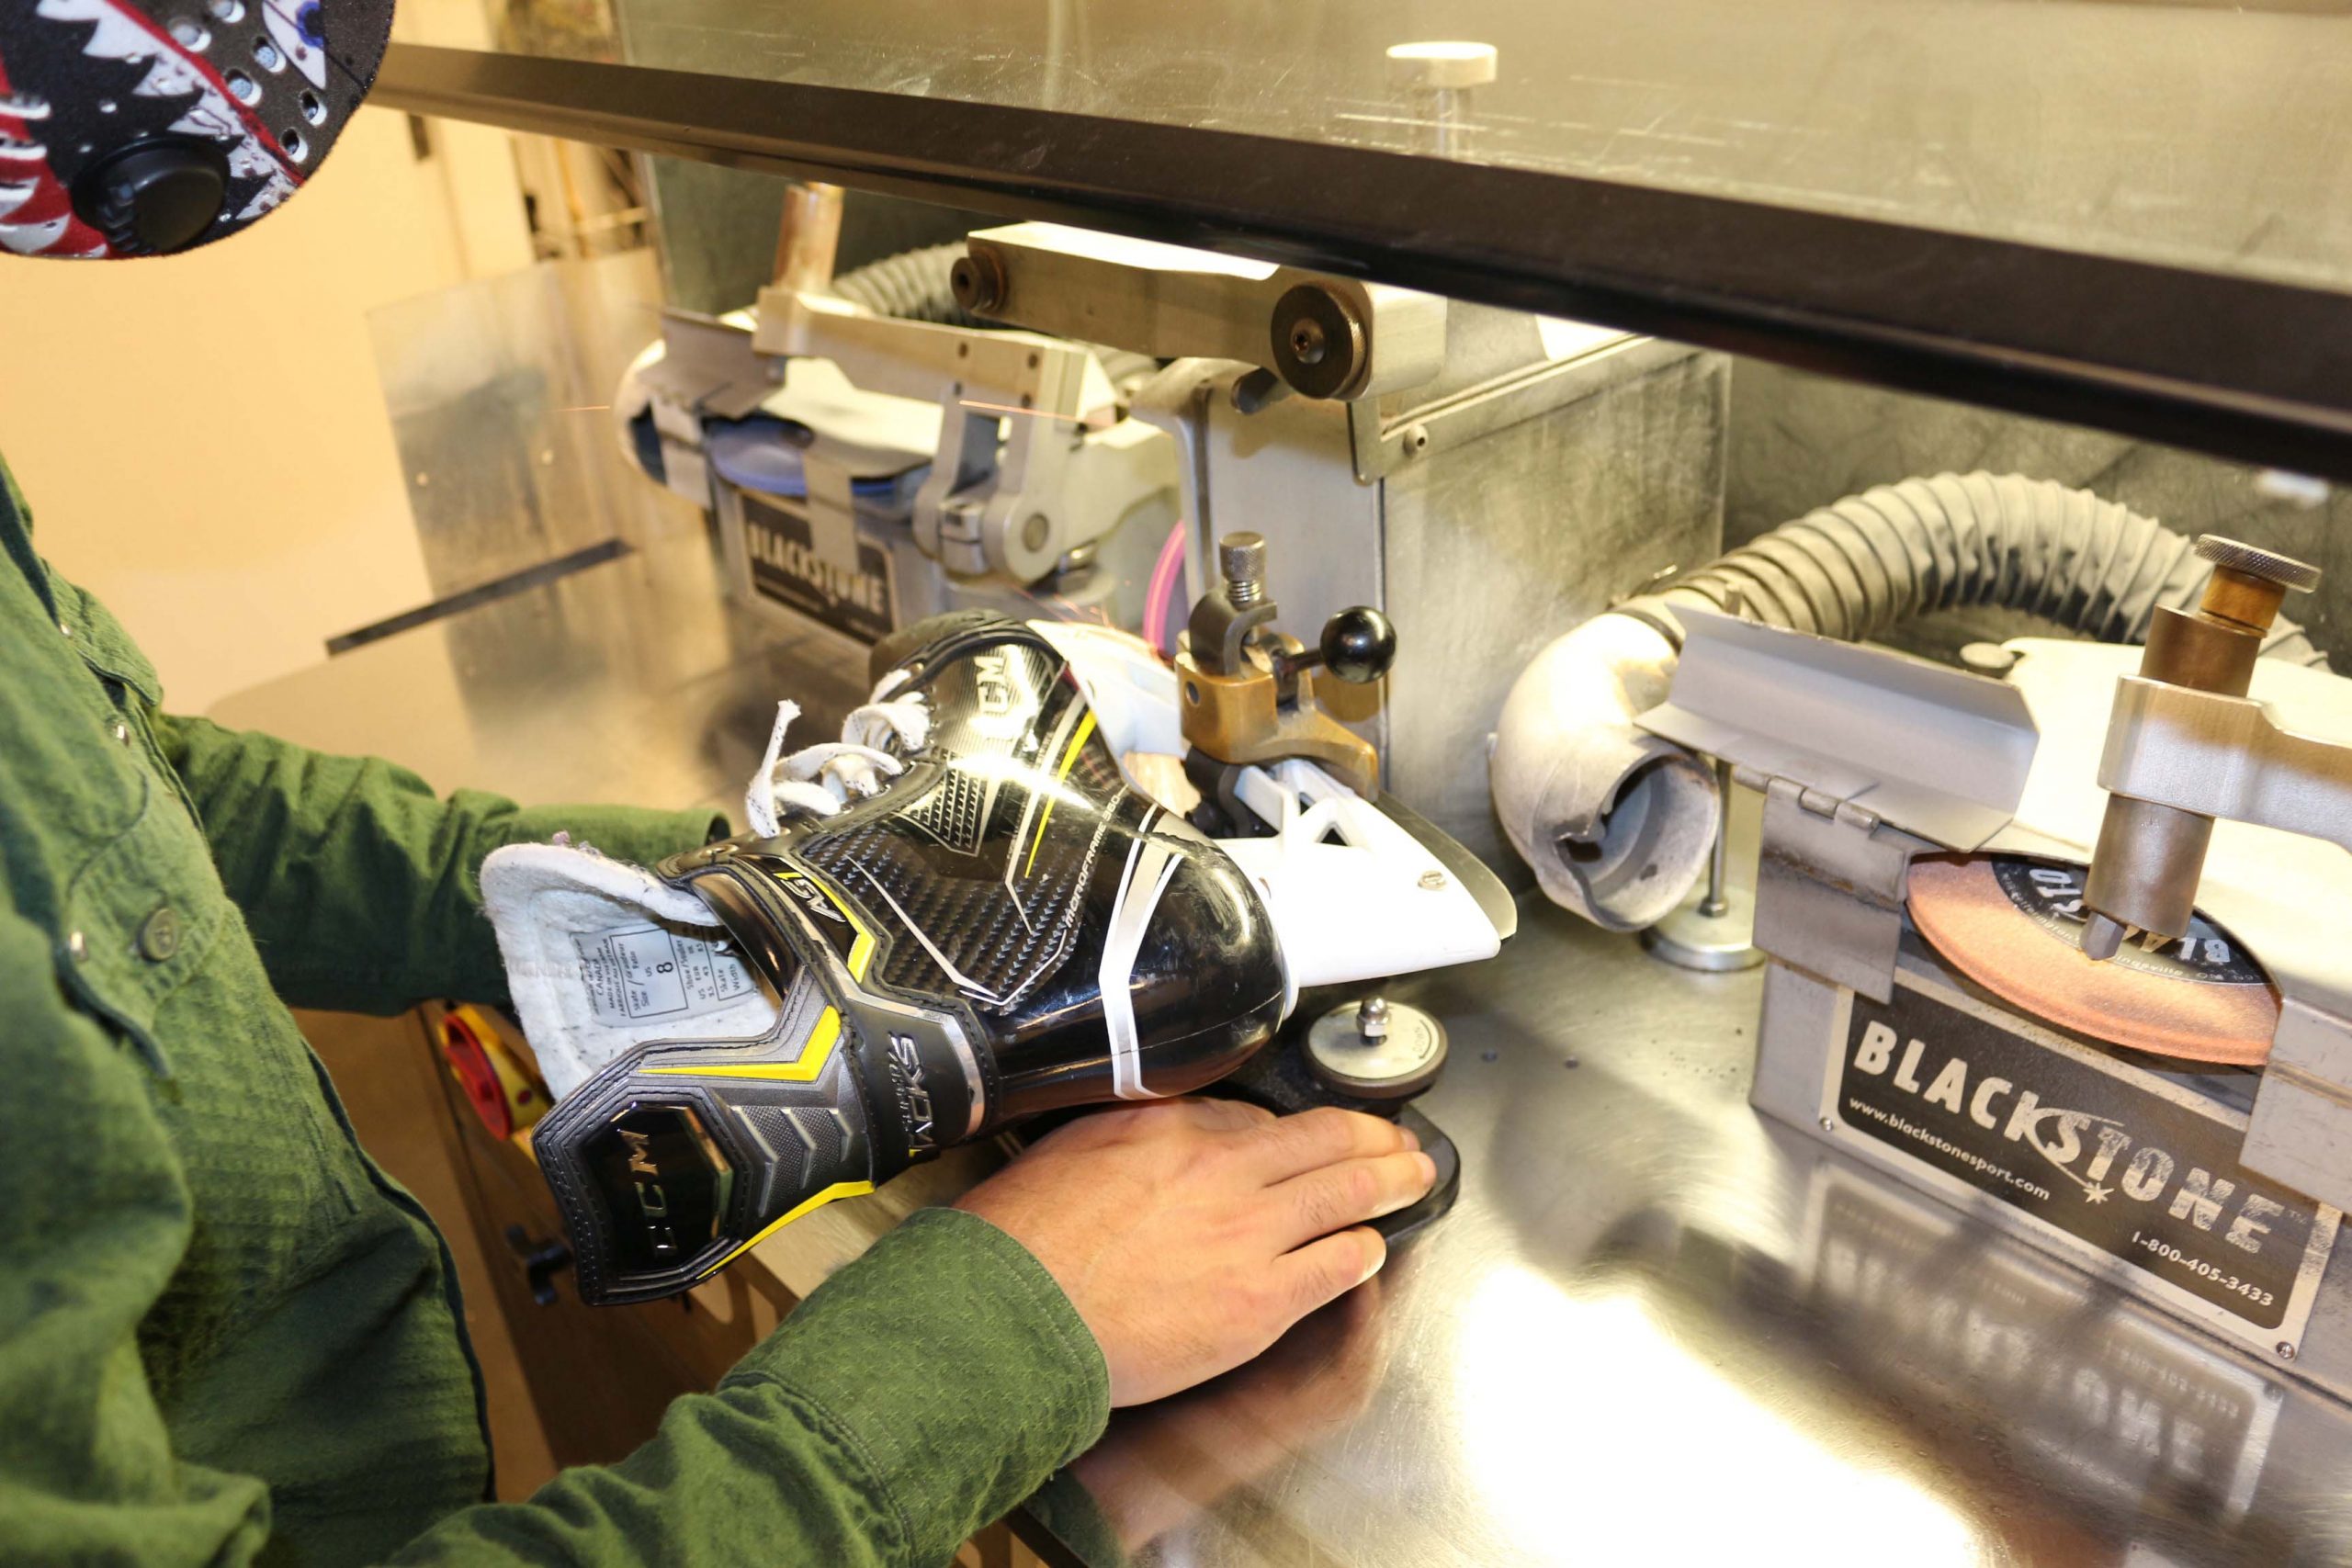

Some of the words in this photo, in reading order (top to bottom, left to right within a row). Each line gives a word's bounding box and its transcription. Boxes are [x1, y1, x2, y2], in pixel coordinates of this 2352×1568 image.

[971, 655, 1016, 740] CM
[1065, 821, 1106, 928] MONOFRAME
[1102, 794, 1120, 821] 360
[645, 966, 652, 977] US
[656, 961, 673, 974] 8
[729, 964, 741, 990] Width
[2115, 954, 2184, 976] ingsville
[718, 968, 729, 992] Skate
[640, 991, 650, 1007] Size
[698, 988, 707, 999] US
[1849, 1098, 2051, 1201] www.blackstonesport.com
[1854, 1020, 2285, 1254] BLACKSTONE
[2131, 1231, 2274, 1307] 1-800-405-3433
